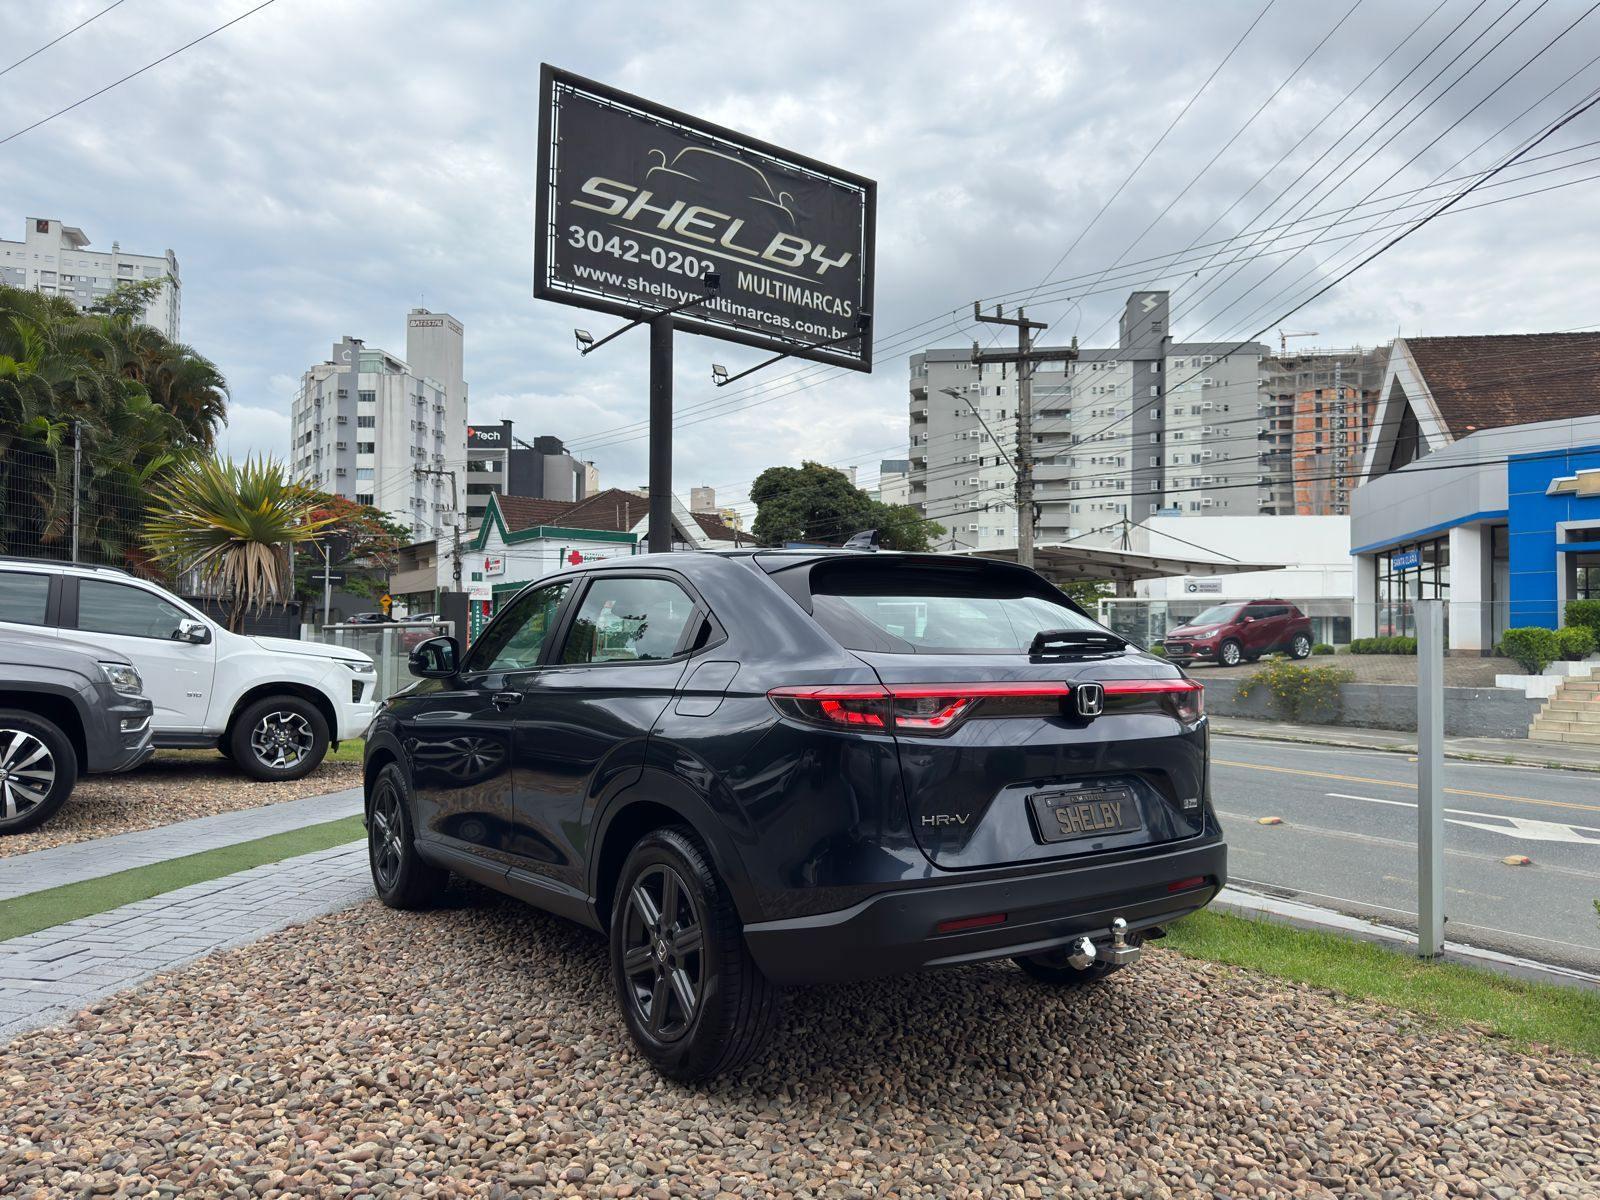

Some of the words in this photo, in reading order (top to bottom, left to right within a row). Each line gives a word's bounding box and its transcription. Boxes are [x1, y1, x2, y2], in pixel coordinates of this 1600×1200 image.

[570, 177, 852, 275] SHELBY
[567, 224, 715, 281] 3042-0202
[737, 270, 852, 318] MULTIMARCAS
[475, 431, 501, 440] Tech
[921, 813, 970, 826] HR-V
[1055, 802, 1123, 834] SHELBY
